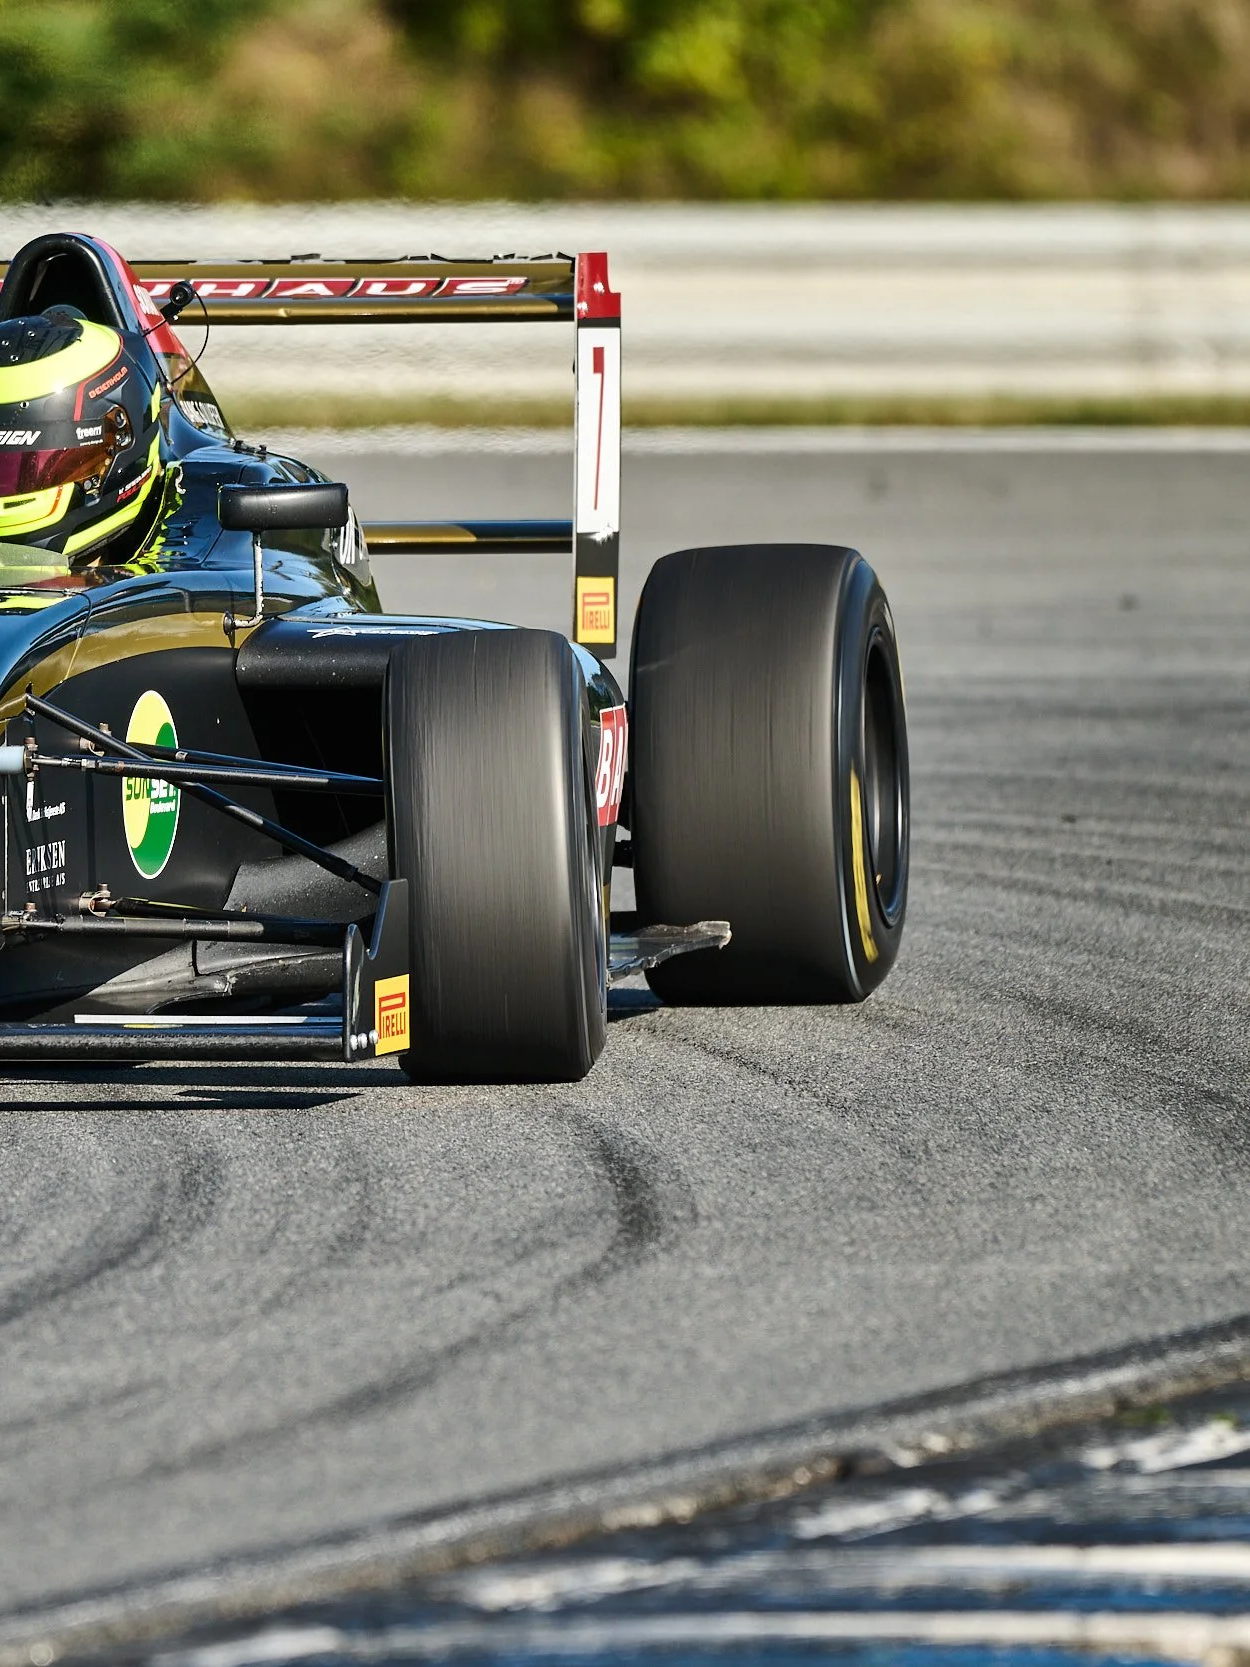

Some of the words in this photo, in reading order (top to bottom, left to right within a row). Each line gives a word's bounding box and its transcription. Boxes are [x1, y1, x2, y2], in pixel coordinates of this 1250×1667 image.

[592, 346, 605, 511] 7
[582, 592, 610, 631] PIRELLI
[26, 840, 66, 875] ERIKSEN
[378, 991, 406, 1040] PIRELLI
